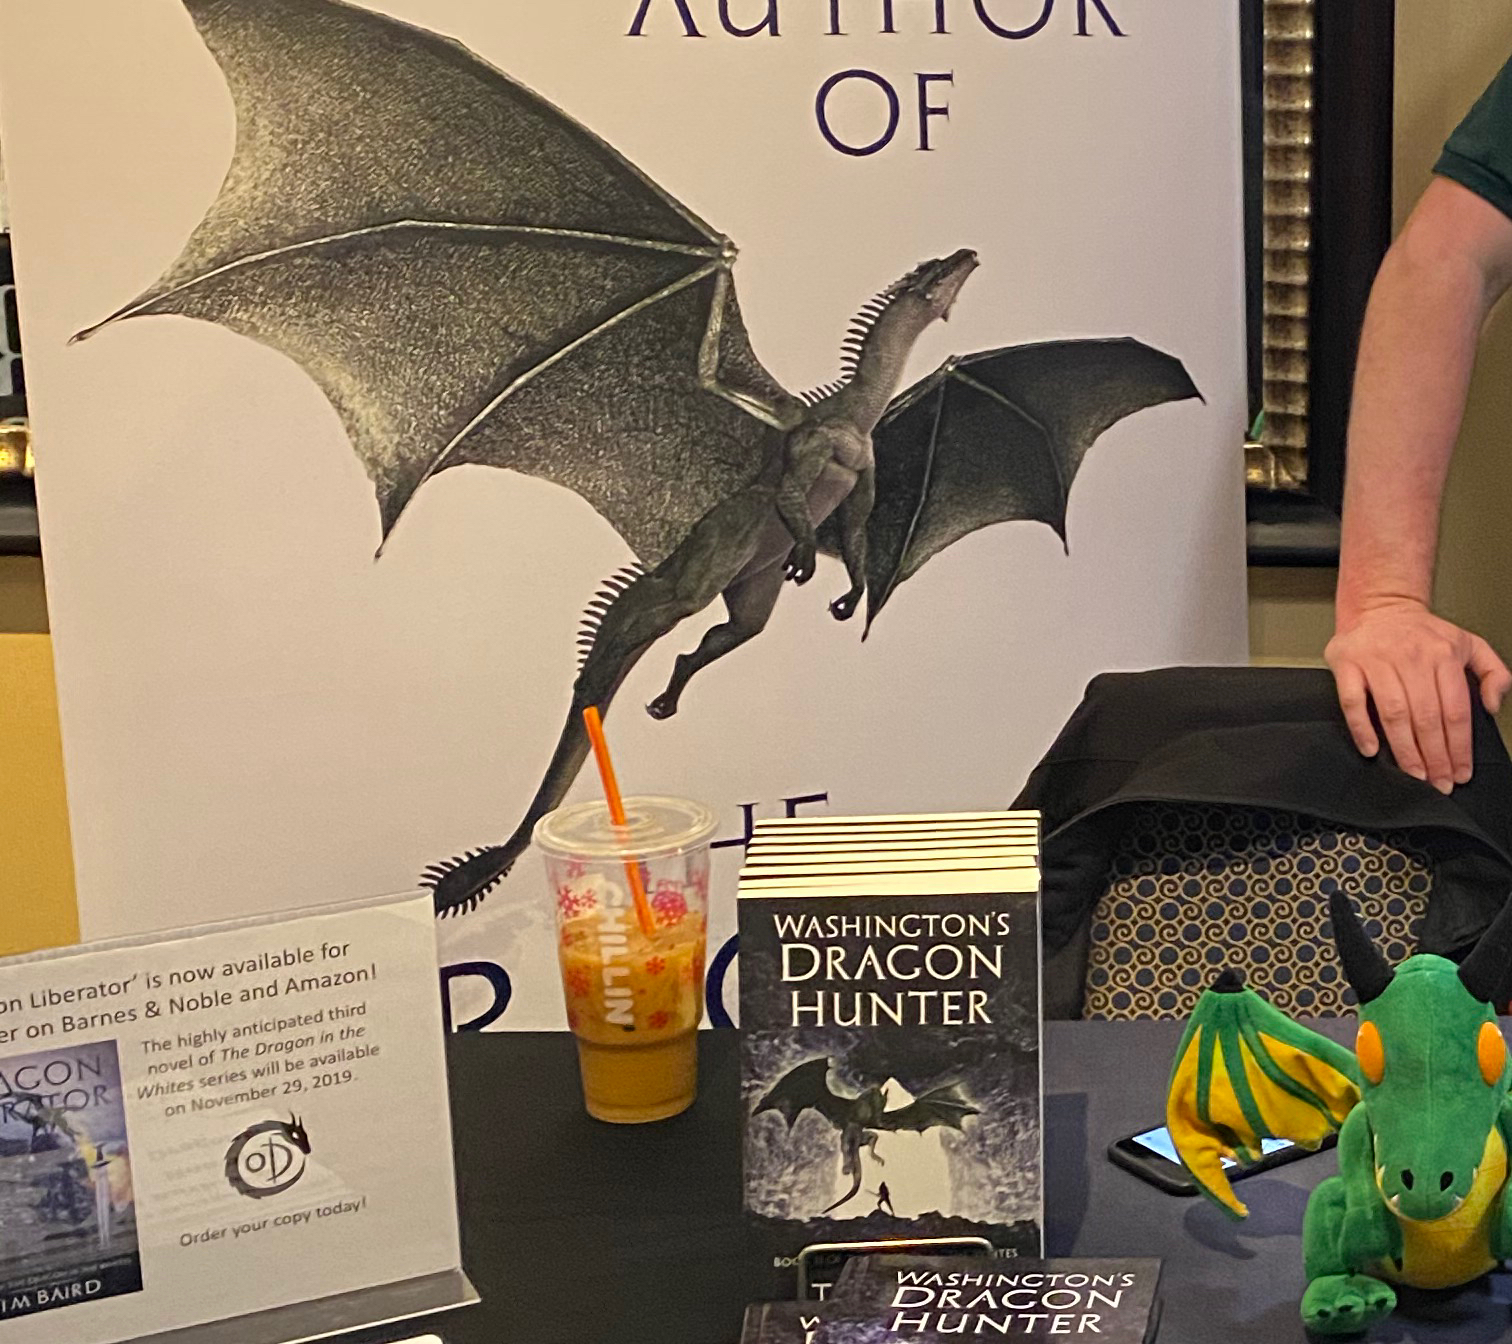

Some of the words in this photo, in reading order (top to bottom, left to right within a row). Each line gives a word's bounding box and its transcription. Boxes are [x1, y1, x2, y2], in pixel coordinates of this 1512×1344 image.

[815, 68, 955, 157] OF
[773, 911, 1010, 938] WASHINGTON'S
[146, 972, 162, 990] is
[169, 965, 215, 986] now
[222, 947, 314, 977] available
[321, 942, 351, 960] for
[780, 942, 1004, 982] DRAGON
[26, 1021, 54, 1038] on
[62, 1008, 138, 1033] Barnes
[145, 1000, 161, 1018] &
[169, 989, 232, 1015] Noble
[240, 979, 279, 1003] and
[285, 963, 377, 995] Amazon!
[791, 989, 993, 1027] HUNTER
[141, 1040, 172, 1055] The
[177, 1028, 227, 1048] highly
[232, 1010, 324, 1038] anticipated
[328, 1002, 366, 1021] third
[148, 1054, 193, 1076] novel
[199, 1049, 216, 1066] of
[221, 1045, 250, 1061] The
[254, 1034, 316, 1057] Dragon
[320, 1030, 334, 1044] in
[339, 1025, 366, 1041] the
[137, 1078, 194, 1100] Whites
[199, 1069, 248, 1089] series
[252, 1060, 281, 1079] will
[284, 1057, 305, 1073] be
[309, 1043, 380, 1068] available
[164, 1103, 186, 1118] on
[191, 1084, 277, 1112] November
[282, 1079, 309, 1096] 29,
[180, 1226, 227, 1247] Order
[231, 1218, 270, 1239] your
[273, 1209, 312, 1228] copy
[316, 1196, 367, 1219] today!
[37, 1279, 102, 1305] BAIRD
[890, 1286, 1123, 1310] DRAGON
[897, 1271, 1136, 1287] WASHINGTON'S
[890, 1311, 1101, 1334] HUNTER
